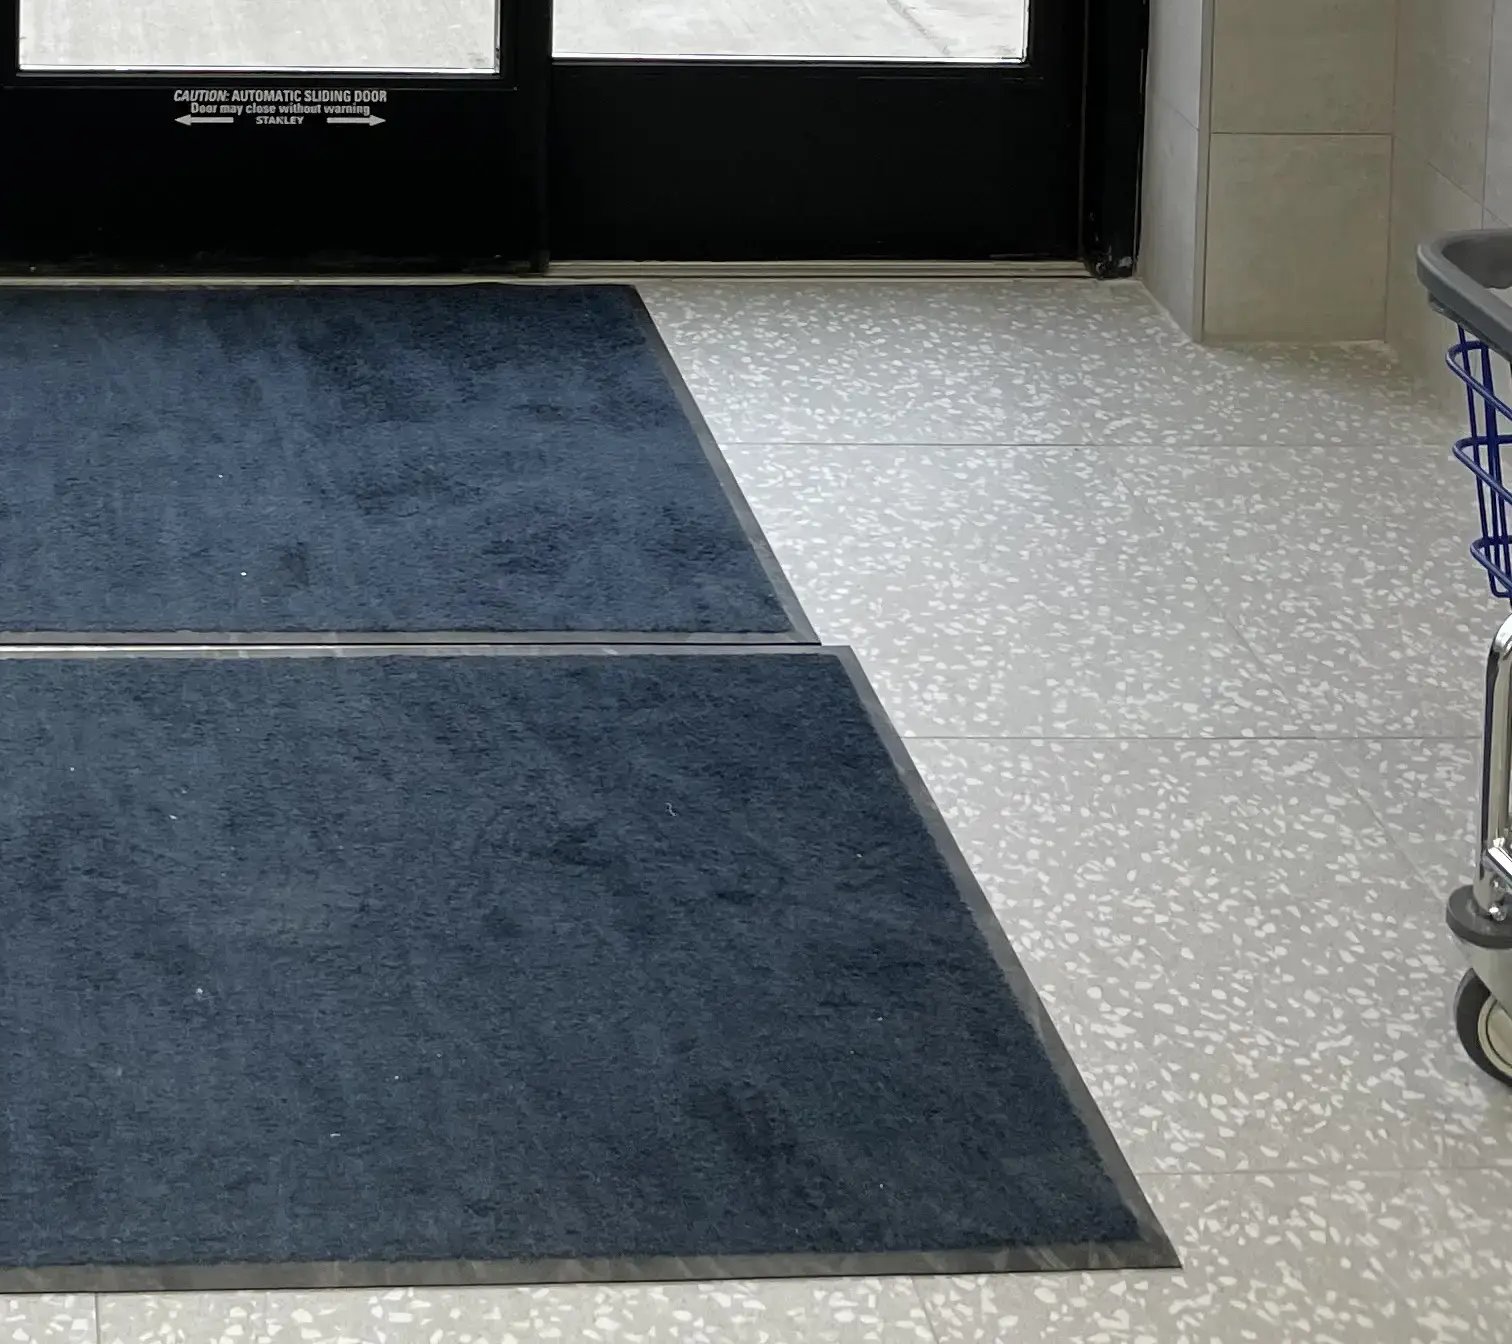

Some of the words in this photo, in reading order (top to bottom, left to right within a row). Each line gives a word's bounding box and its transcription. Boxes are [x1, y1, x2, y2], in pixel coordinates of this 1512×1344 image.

[173, 90, 229, 102] CAUTION:
[231, 90, 301, 102] AUTOMATIC
[303, 90, 351, 102] SLIDING
[354, 90, 387, 102] DOOR
[190, 102, 217, 113] Door
[219, 105, 242, 116] may
[245, 102, 276, 113] close
[278, 102, 321, 113] without
[324, 103, 370, 115] warning
[256, 116, 304, 125] STANLEY
